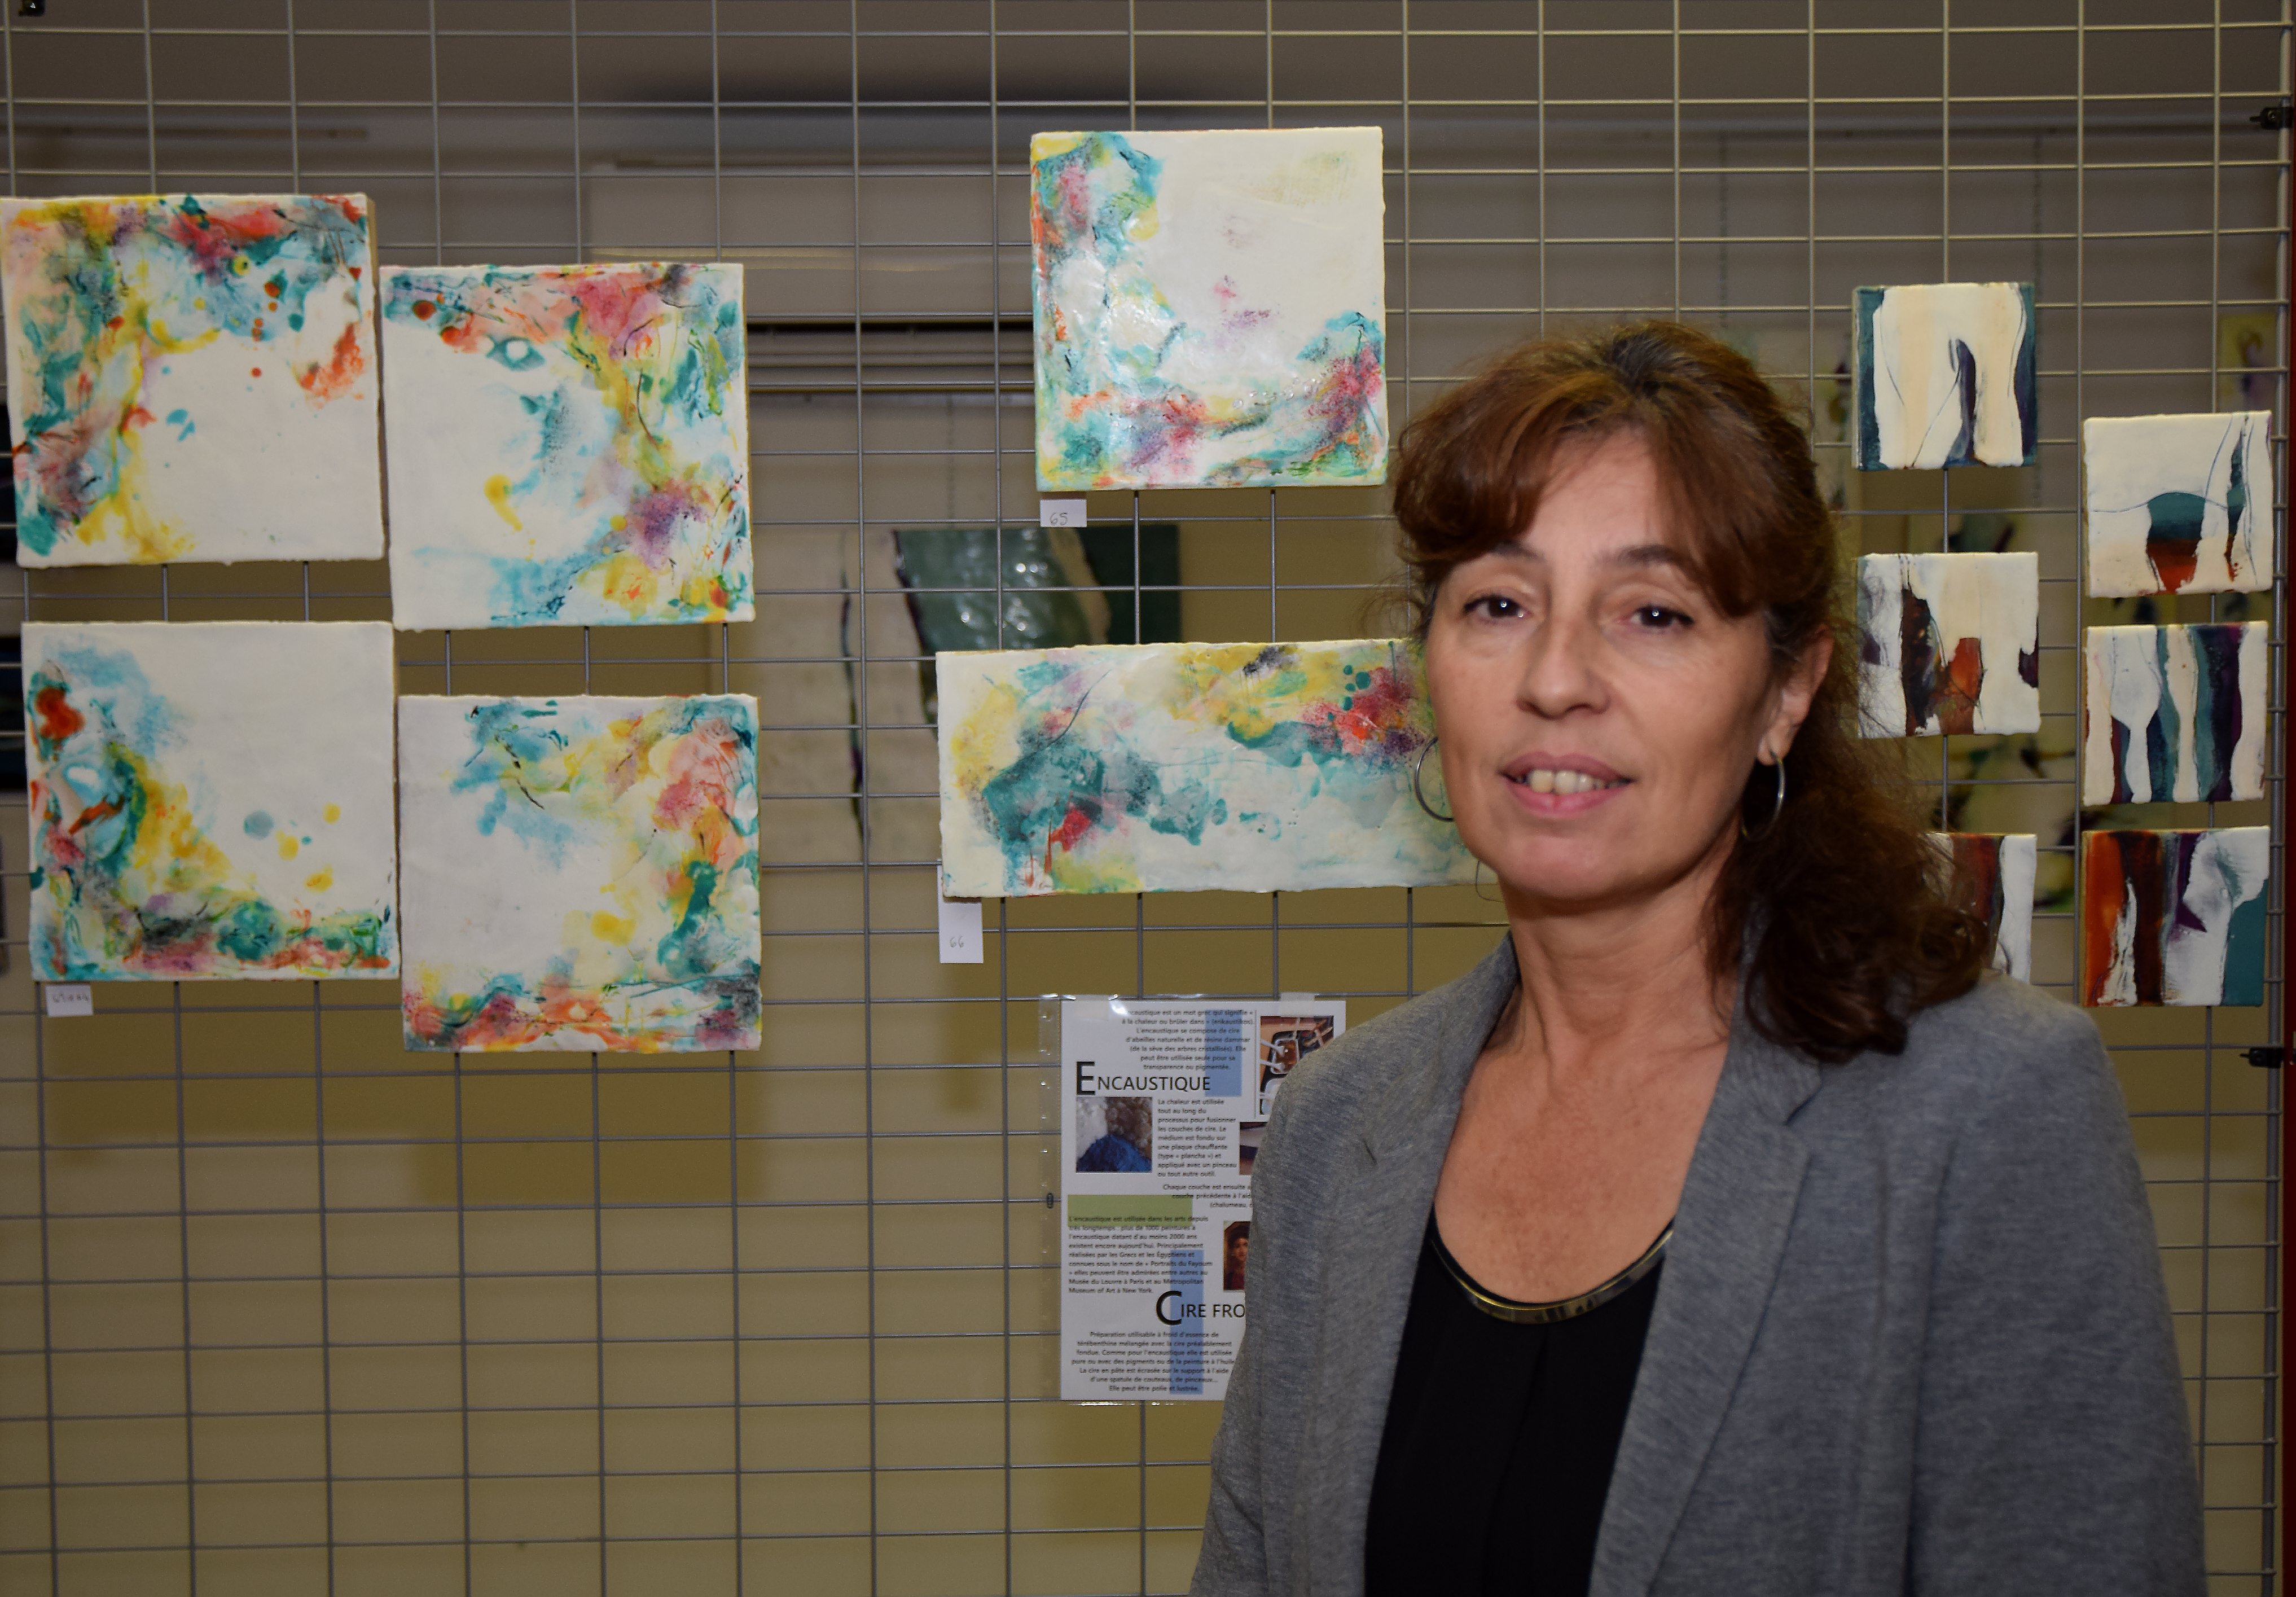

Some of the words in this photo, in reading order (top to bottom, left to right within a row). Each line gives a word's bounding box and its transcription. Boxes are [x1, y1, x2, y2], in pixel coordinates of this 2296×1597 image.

[1050, 512, 1068, 525] 65
[950, 936, 964, 948] 66
[1076, 1061, 1211, 1095] ENCAUSTIQUE
[1156, 1290, 1206, 1326] CIRE
